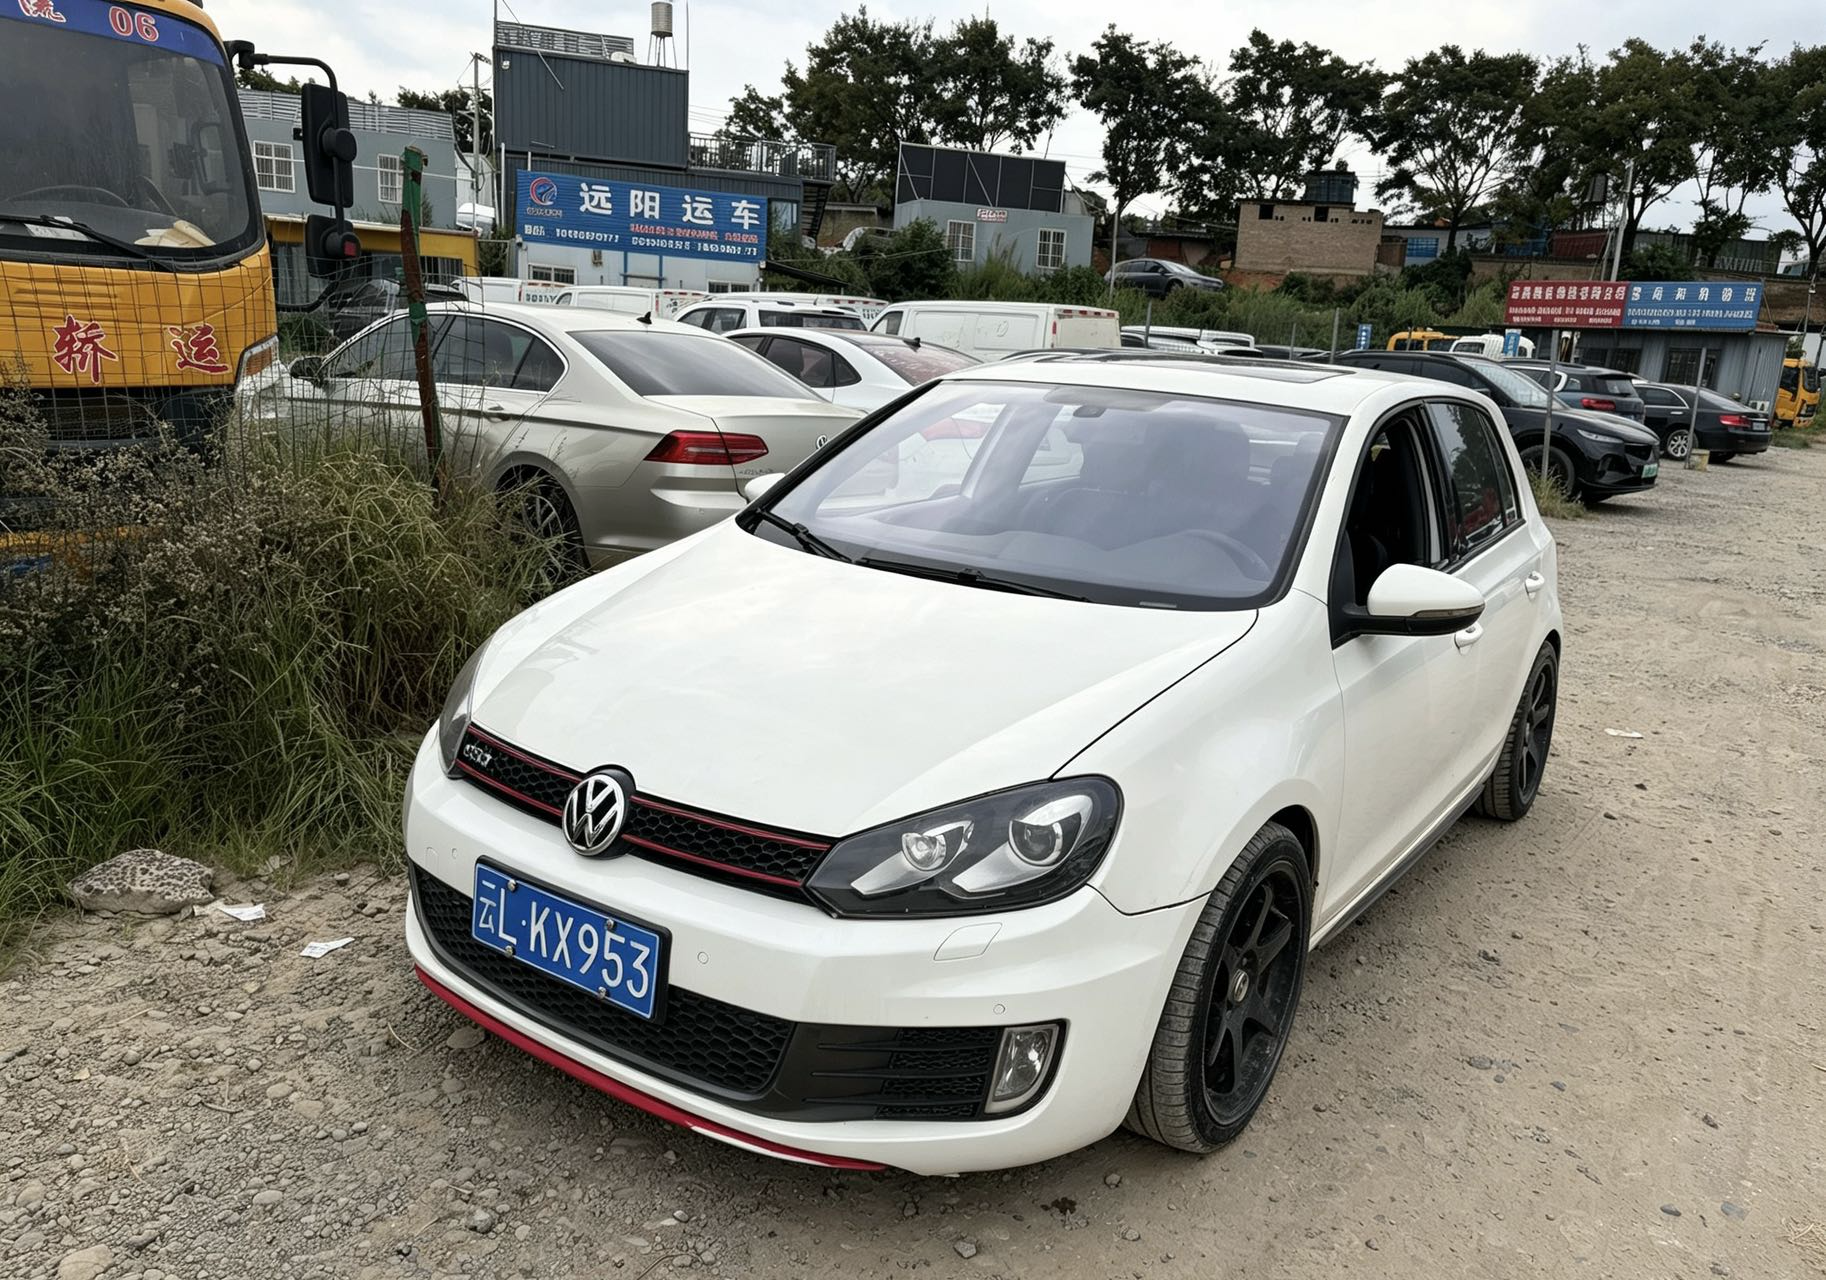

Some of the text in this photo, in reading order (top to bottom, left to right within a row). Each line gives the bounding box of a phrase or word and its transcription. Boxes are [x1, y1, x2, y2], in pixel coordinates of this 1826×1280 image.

[109, 5, 159, 42] 06
[579, 182, 760, 230] 远阳运车
